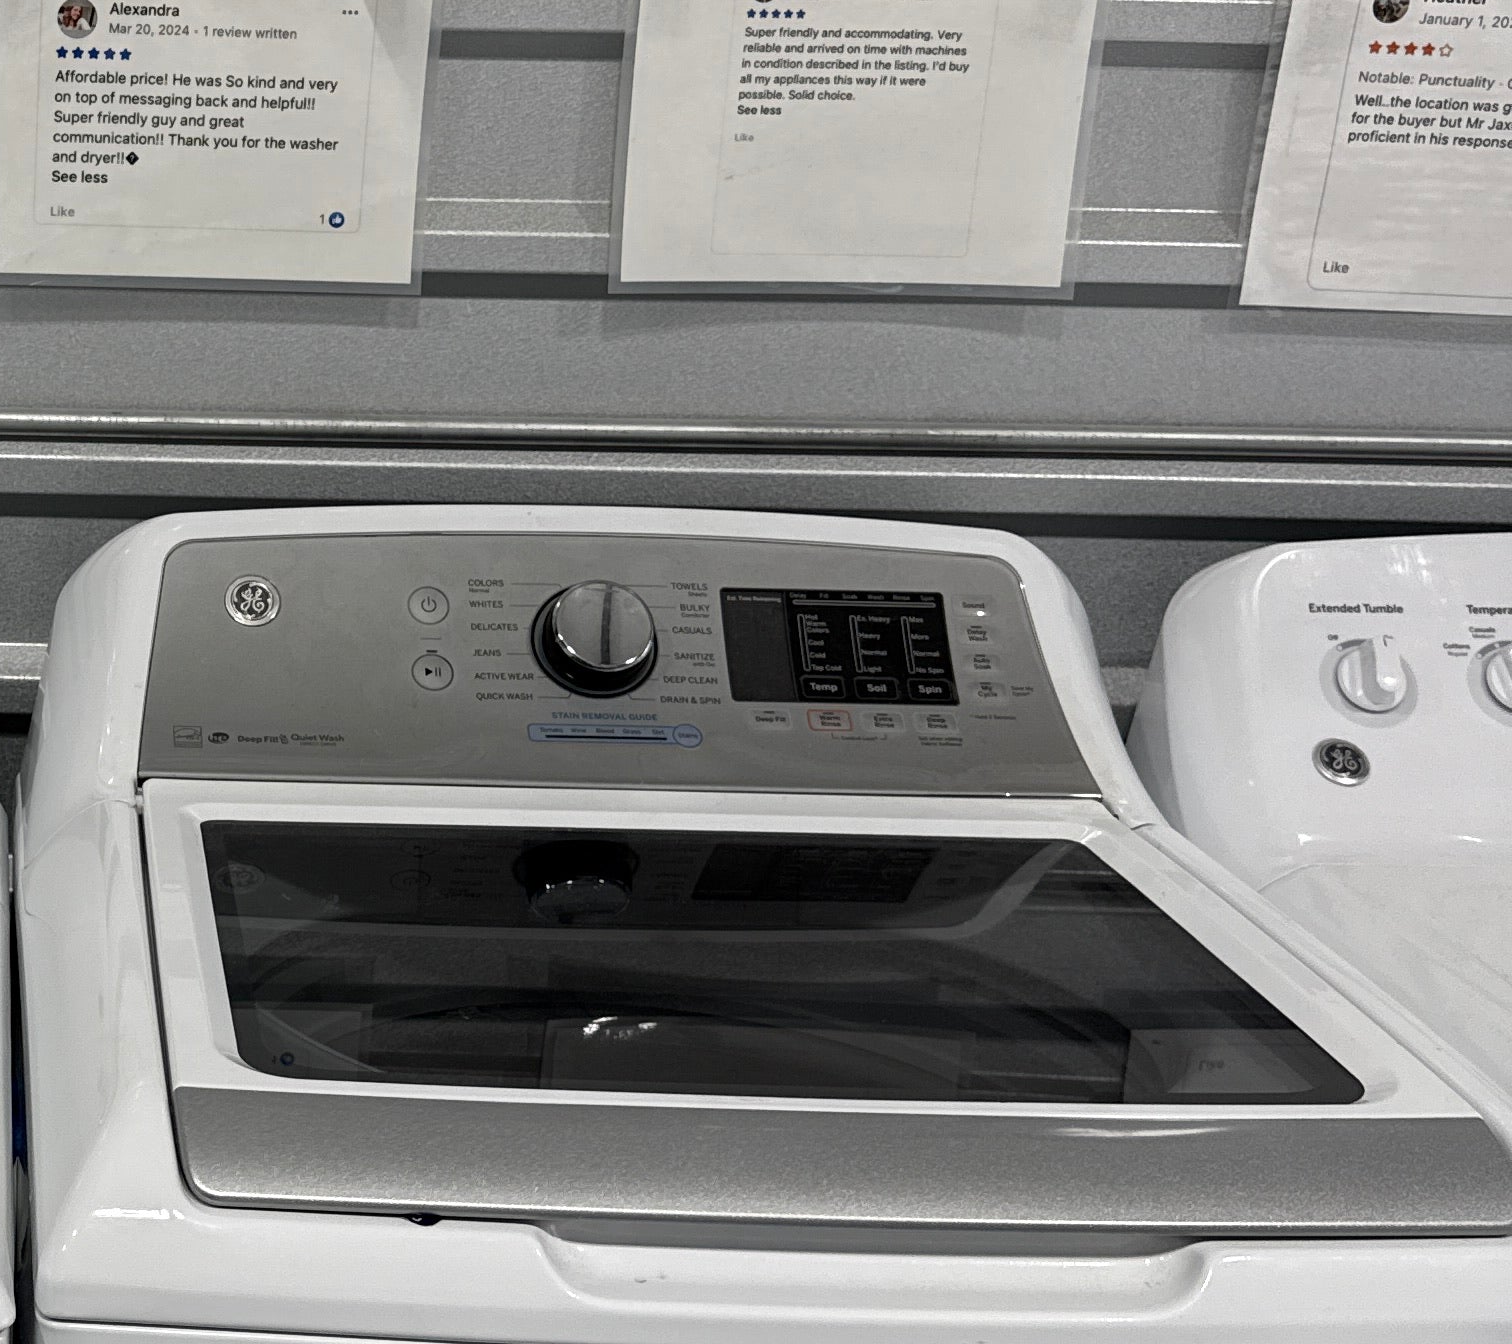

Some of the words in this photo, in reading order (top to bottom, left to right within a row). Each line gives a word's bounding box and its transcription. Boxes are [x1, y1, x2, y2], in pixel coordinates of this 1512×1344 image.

[109, 1, 180, 17] Alexandra
[744, 26, 777, 39] Super
[779, 26, 820, 40] friendly
[821, 27, 842, 39] and
[937, 29, 963, 43] Very
[1358, 70, 1415, 85] Notable:
[1418, 73, 1496, 92] Punctuality
[53, 109, 94, 126] Super
[97, 110, 148, 128] friendly
[151, 115, 177, 129] guy
[179, 114, 206, 127] and
[208, 116, 245, 130] great
[51, 169, 78, 183] See
[81, 169, 108, 184] less
[467, 578, 505, 588] COLORS
[670, 581, 709, 592] TOWELS
[468, 599, 504, 609] WHITES
[679, 603, 710, 612] BULKY
[1308, 602, 1362, 614] Extended
[1362, 603, 1404, 614] Tumble
[470, 622, 519, 632] DELICATES
[671, 625, 713, 635] CASUALS
[472, 648, 502, 657] JEANS
[673, 651, 716, 662] SANITIZE
[473, 672, 507, 681] ACTIVE
[507, 672, 534, 681] WEAR
[662, 675, 687, 684] DEEP
[687, 676, 719, 685] CLEAN
[809, 682, 838, 693] Temp
[866, 683, 887, 693] Soil
[918, 684, 943, 695] Spin
[475, 692, 505, 702] QUICK
[505, 692, 534, 701] WASH
[551, 711, 580, 720] STAIN
[628, 713, 658, 722] GUIDE
